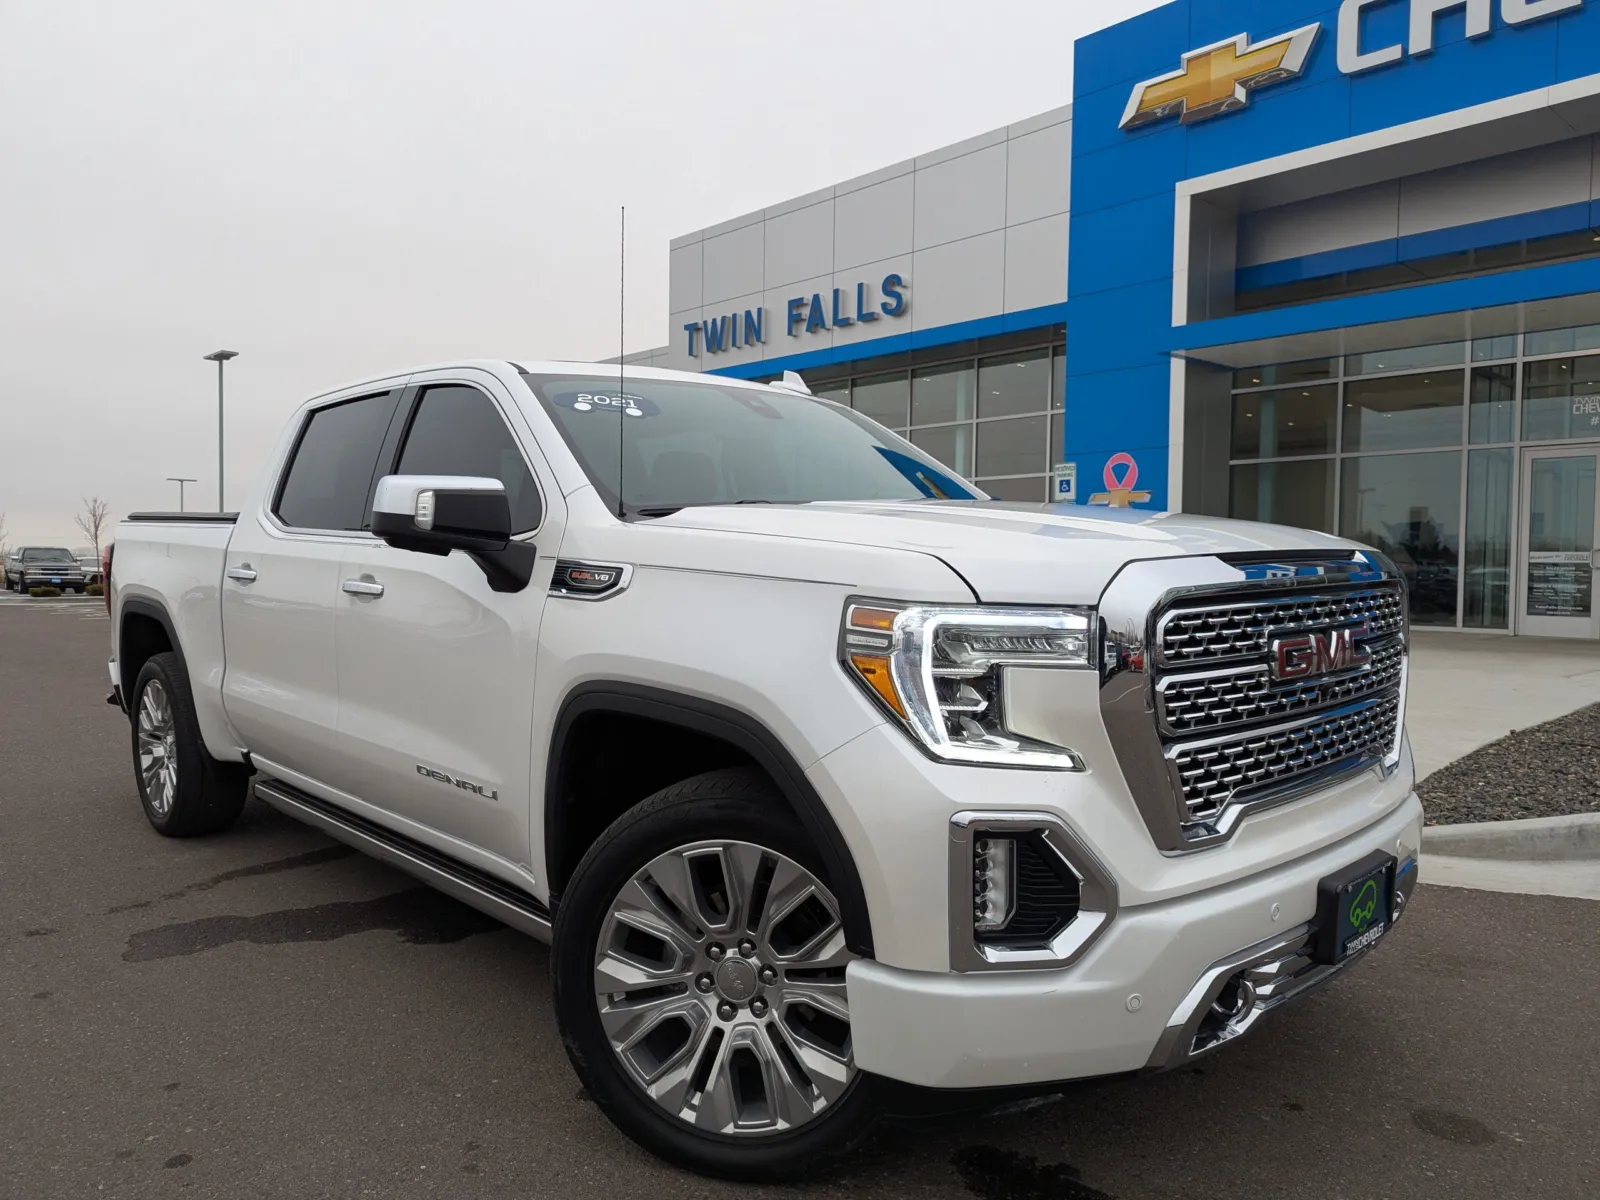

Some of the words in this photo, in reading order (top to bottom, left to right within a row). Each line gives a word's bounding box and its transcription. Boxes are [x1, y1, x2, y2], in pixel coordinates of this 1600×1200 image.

[684, 307, 767, 358] TWIN
[787, 274, 908, 337] FALLS
[577, 393, 638, 409] 2021
[594, 573, 609, 581] V8
[1272, 628, 1371, 681] GMC
[416, 763, 498, 801] DENALI
